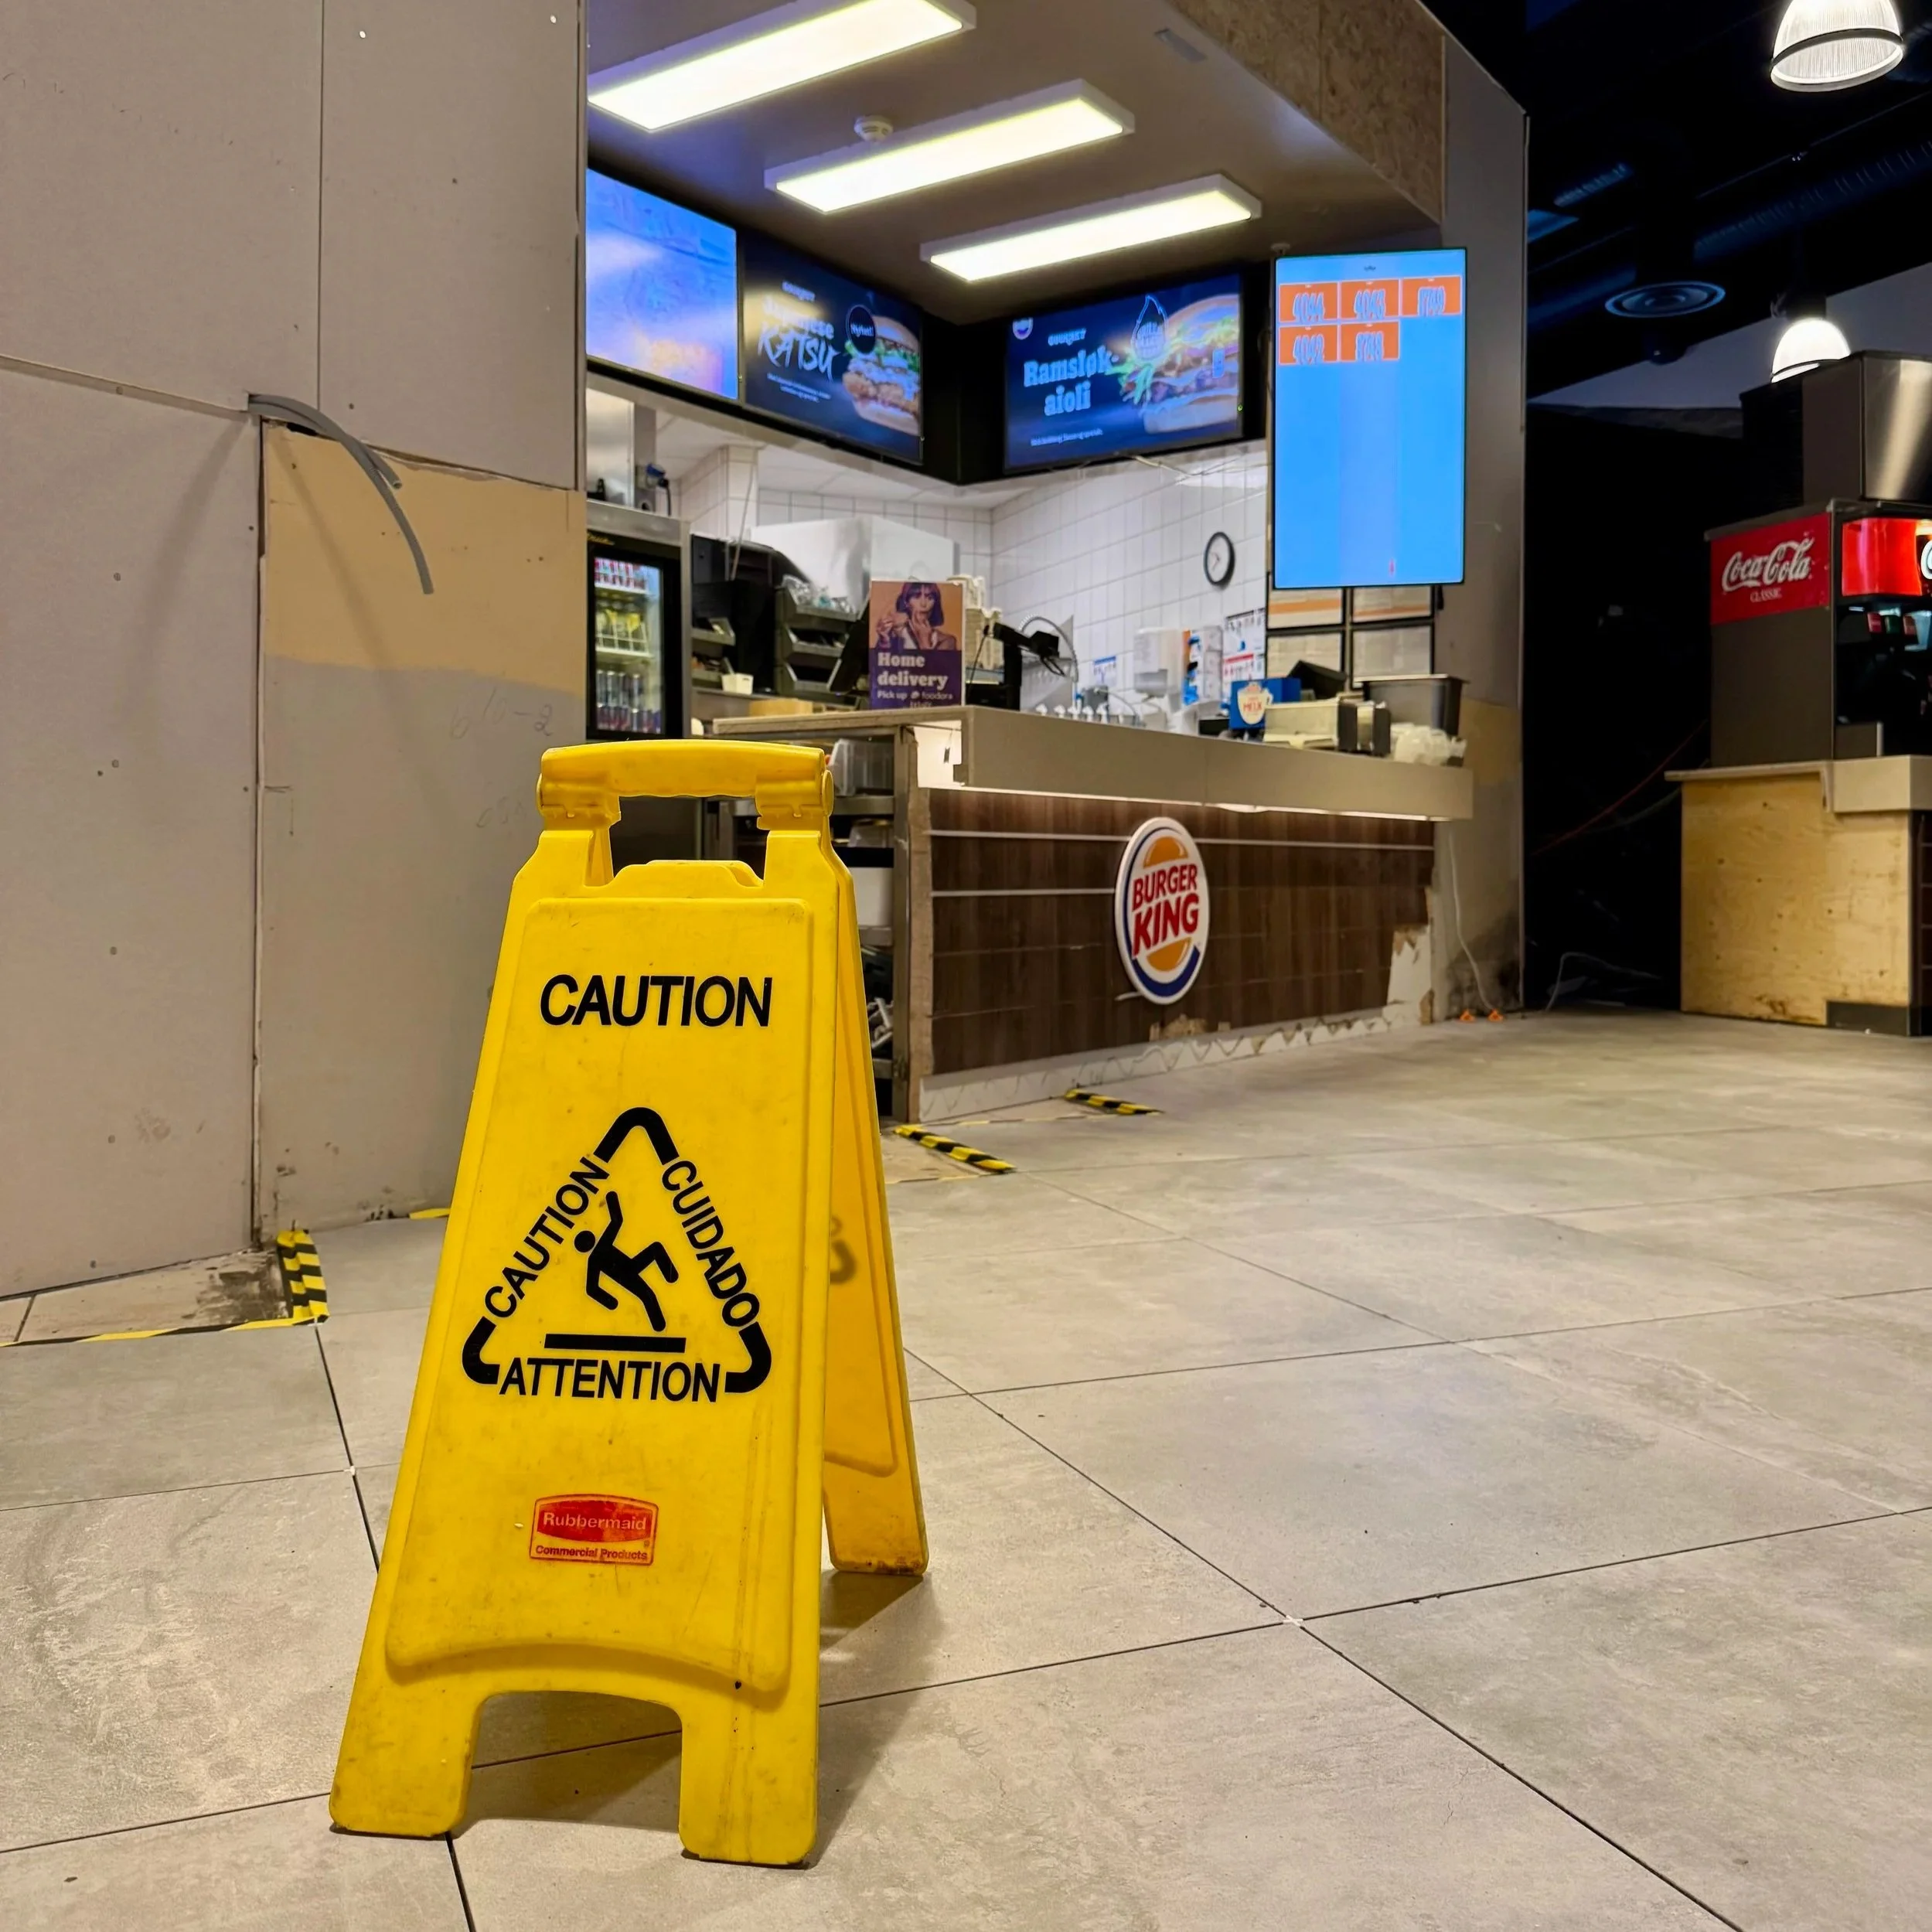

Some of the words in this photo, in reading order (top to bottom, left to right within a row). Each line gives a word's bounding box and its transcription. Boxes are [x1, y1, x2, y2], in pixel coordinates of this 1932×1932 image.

[757, 320, 840, 383] KATSU
[1044, 380, 1091, 416] aioli
[877, 653, 925, 668] Home
[877, 671, 949, 690] delivery
[877, 690, 895, 699] Pick
[896, 692, 908, 700] up
[1131, 864, 1198, 912] BURGER
[1131, 893, 1200, 959] KING
[540, 974, 772, 1027] CAUTION
[484, 1156, 610, 1319] CAUTION
[662, 1160, 760, 1327] CUIDADO
[499, 1357, 720, 1402] ATTENTION
[543, 1511, 647, 1531] Rubbermaid
[536, 1545, 598, 1558] Commercial
[599, 1549, 648, 1560] Products
